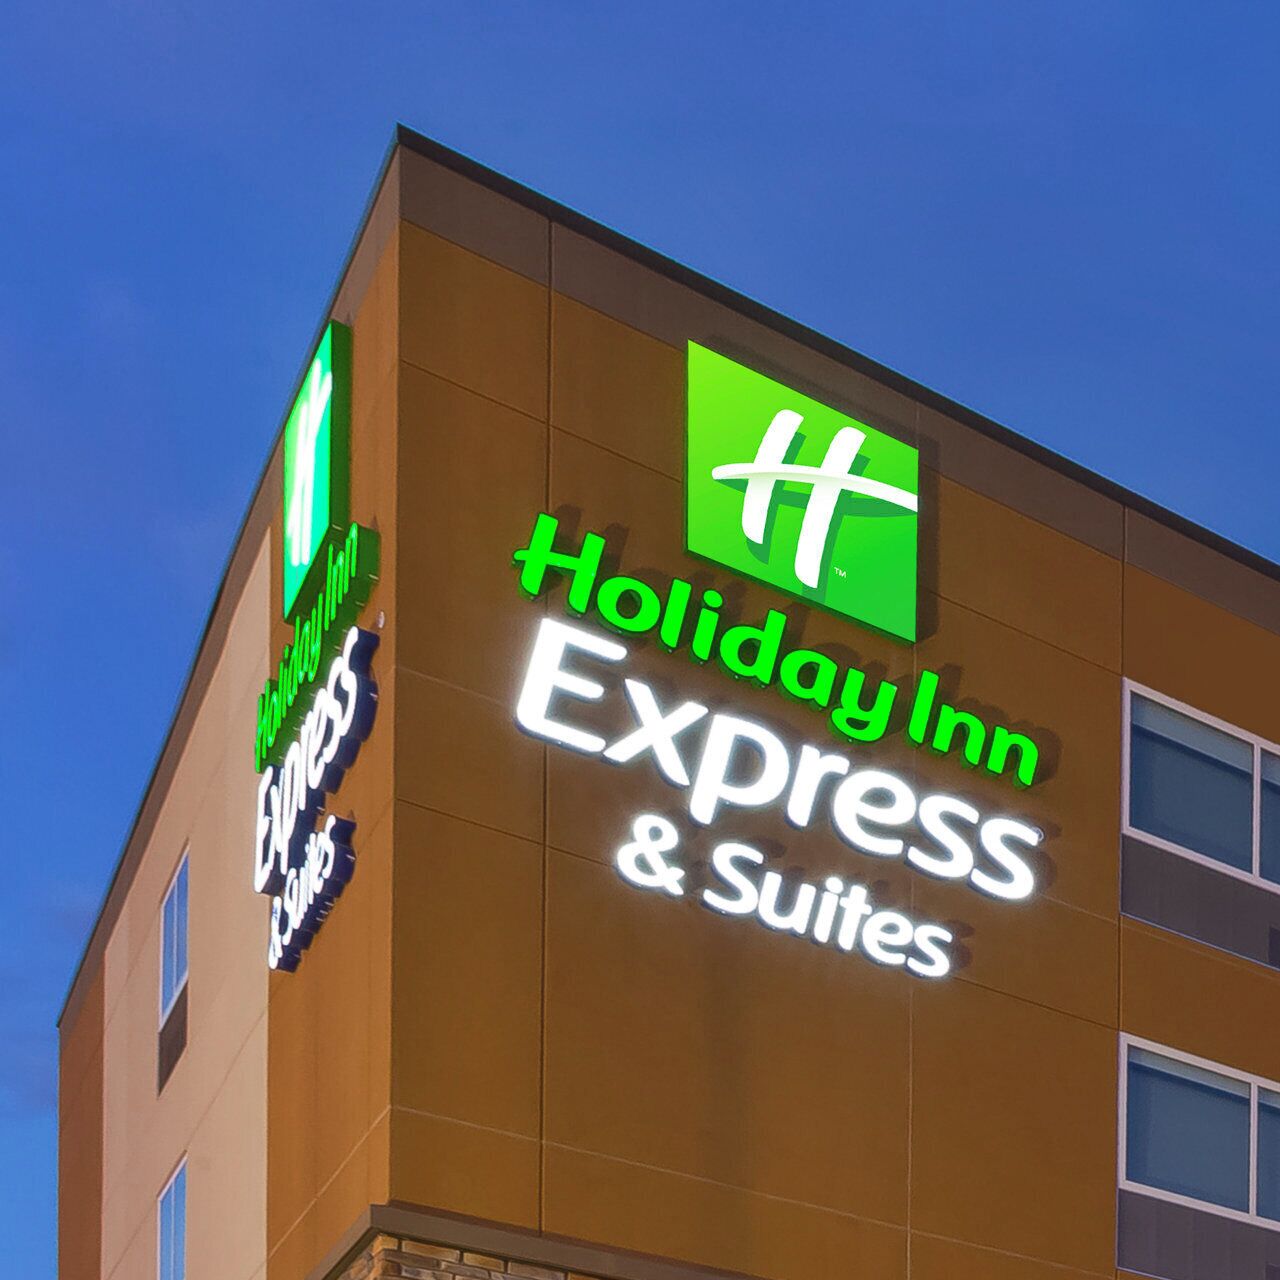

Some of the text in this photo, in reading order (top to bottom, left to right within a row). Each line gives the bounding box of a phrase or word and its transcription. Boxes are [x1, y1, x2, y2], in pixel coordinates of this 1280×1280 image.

[254, 625, 358, 893] Express
[255, 522, 358, 773] Holiday Inn
[512, 512, 1039, 787] Holiday Inn
[514, 617, 1040, 900] Express
[283, 814, 336, 946] Suites
[617, 813, 953, 978] & Suites
